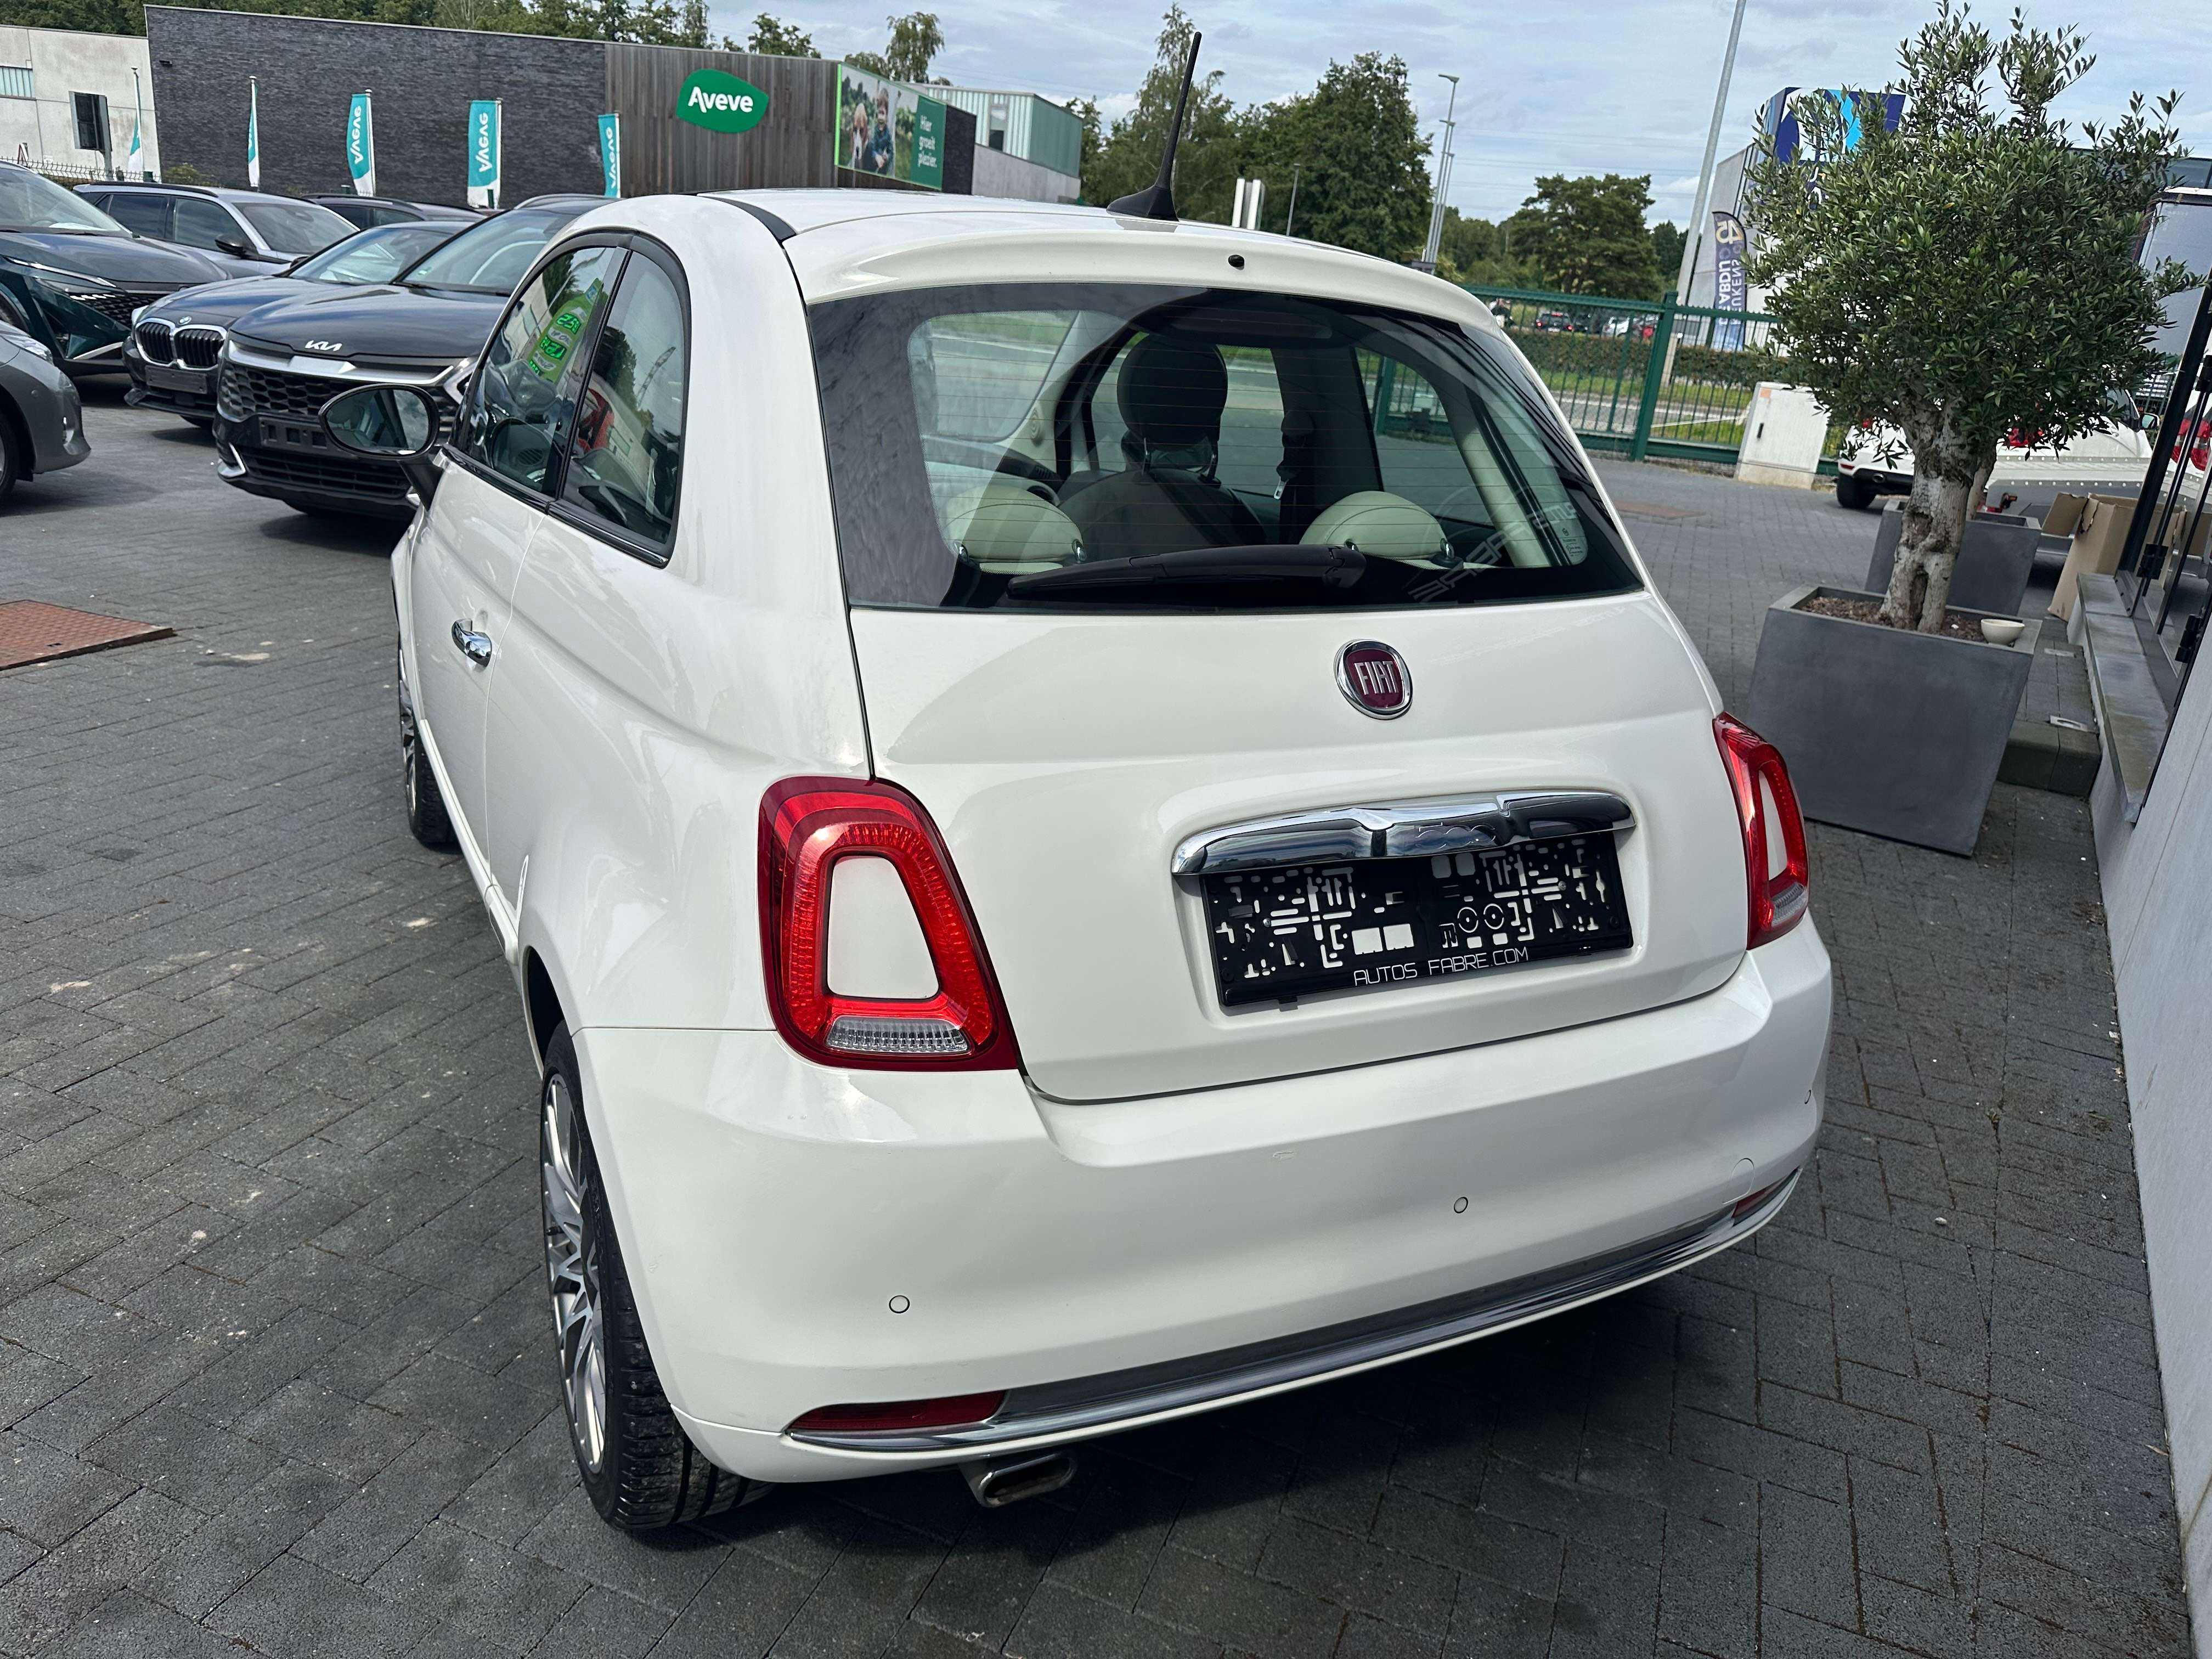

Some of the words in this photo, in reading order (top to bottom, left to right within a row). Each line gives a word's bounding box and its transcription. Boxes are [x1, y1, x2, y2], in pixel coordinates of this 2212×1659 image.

[687, 86, 753, 113] Aveve
[1355, 661, 1399, 695] FIAT
[1353, 962, 1417, 986] AUTOS
[1428, 946, 1528, 975] FABRE.COM
